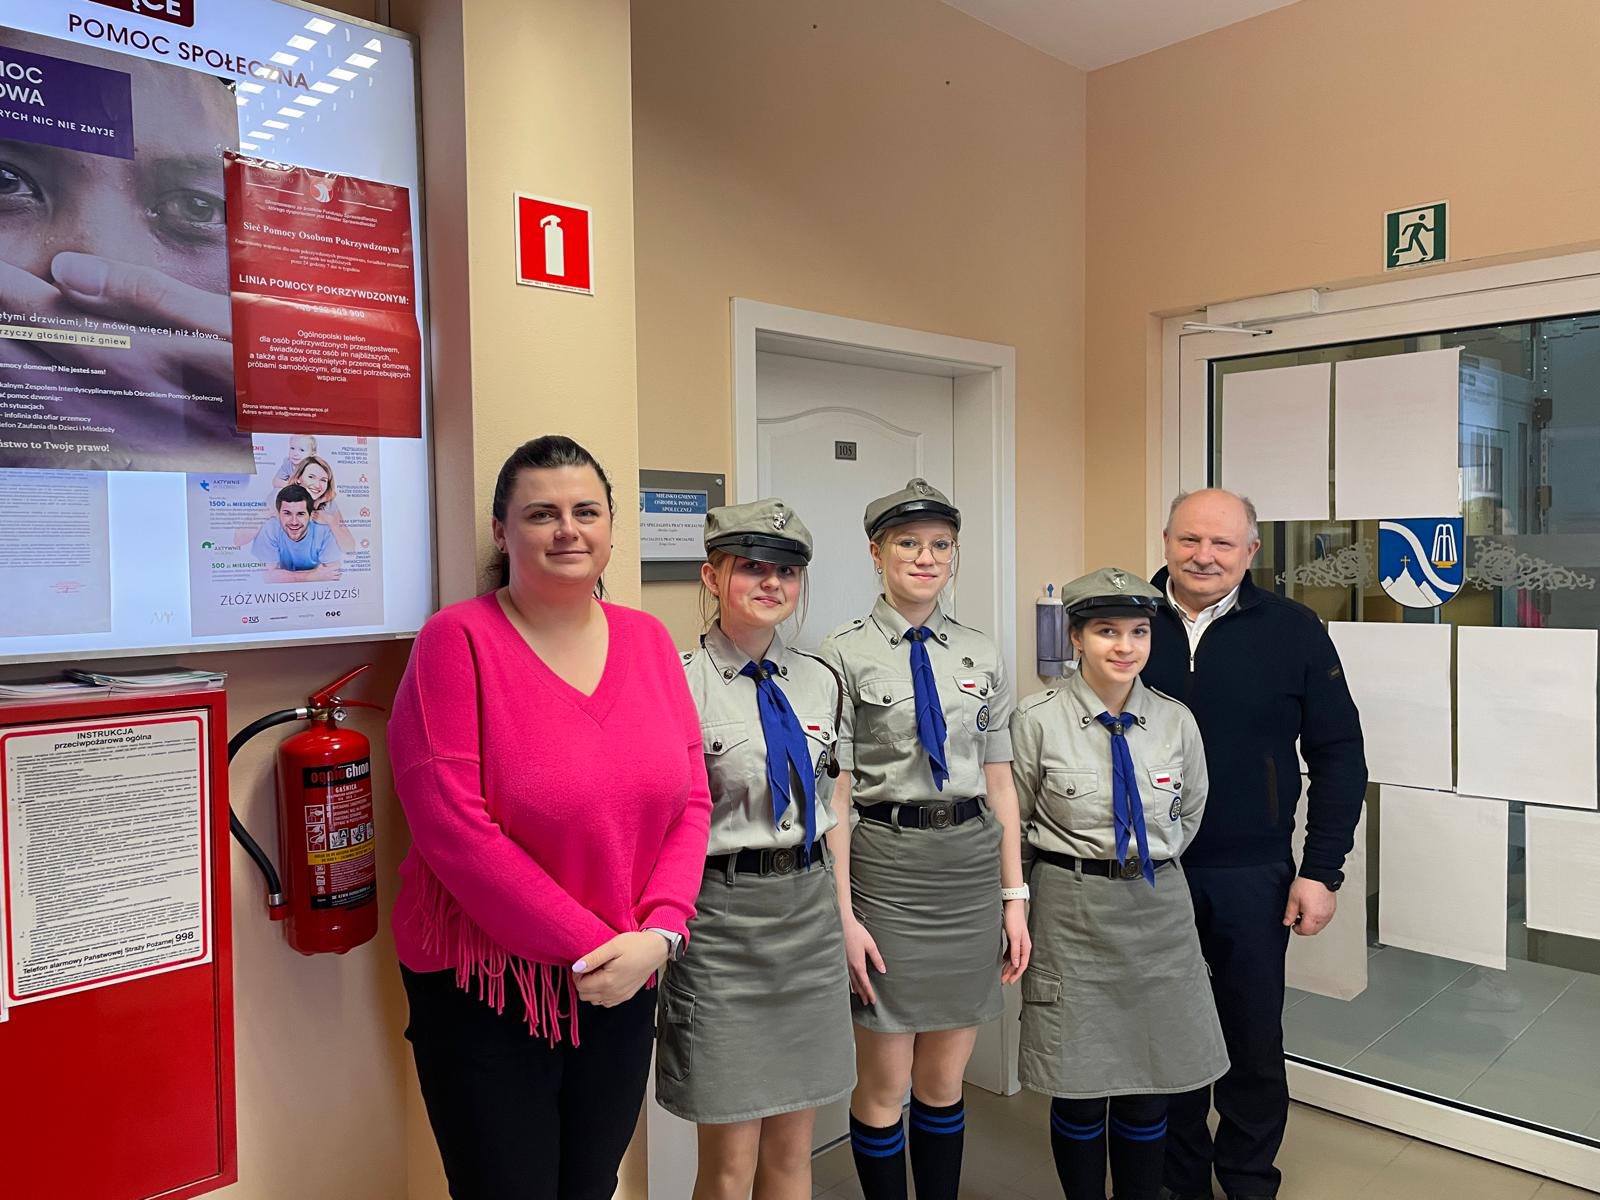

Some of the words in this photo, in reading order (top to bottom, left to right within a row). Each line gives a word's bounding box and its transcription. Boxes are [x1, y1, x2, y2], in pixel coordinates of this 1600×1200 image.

[69, 14, 170, 54] POMOC
[178, 41, 310, 90] SPOŁECZNA
[32, 115, 54, 126] NIC
[58, 120, 76, 130] NIE
[80, 124, 116, 138] ZMYJE
[243, 221, 261, 232] Sieć
[263, 225, 297, 239] Pomocy
[298, 232, 333, 243] Osobom
[335, 237, 400, 254] Pokrzywdzonym
[239, 274, 267, 286] LINIA
[270, 278, 314, 292] POMOCY
[317, 285, 409, 304] POKRZYWDZONYM:
[30, 313, 82, 328] drzwiami,
[84, 318, 98, 330] łzy
[102, 322, 136, 334] mówią
[139, 325, 172, 337] więcej
[175, 329, 189, 337] niż
[98, 337, 127, 346] gniew
[298, 330, 342, 340] Ogólnopolski
[269, 345, 304, 354] świadków
[292, 339, 348, 349] pokrzywdzonych
[22, 363, 57, 372] domowej?
[70, 366, 90, 374] jesteś
[308, 356, 347, 366] dotkniętych
[349, 361, 381, 369] przemocą
[363, 370, 411, 379] potrzebujących
[58, 385, 123, 396] Interdyscyplinarnym
[134, 390, 168, 398] Ośrodkiem
[44, 441, 74, 452] Twoje
[77, 444, 110, 453] prawo!
[839, 445, 852, 456] 105
[220, 591, 252, 606] ZŁÓŻ
[254, 591, 309, 604] WNIOSEK
[311, 587, 331, 601] JUŻ
[334, 586, 360, 599] DZIŚ!
[77, 728, 134, 740] INSTRUKCJA
[54, 737, 123, 751] przeciwpożarowa
[126, 734, 152, 742] ogólna
[23, 965, 48, 974] Telefon
[49, 958, 83, 969] alarmowy
[84, 949, 123, 961] Państwowej
[146, 938, 174, 949] Pożarnej
[175, 931, 194, 942] 998
